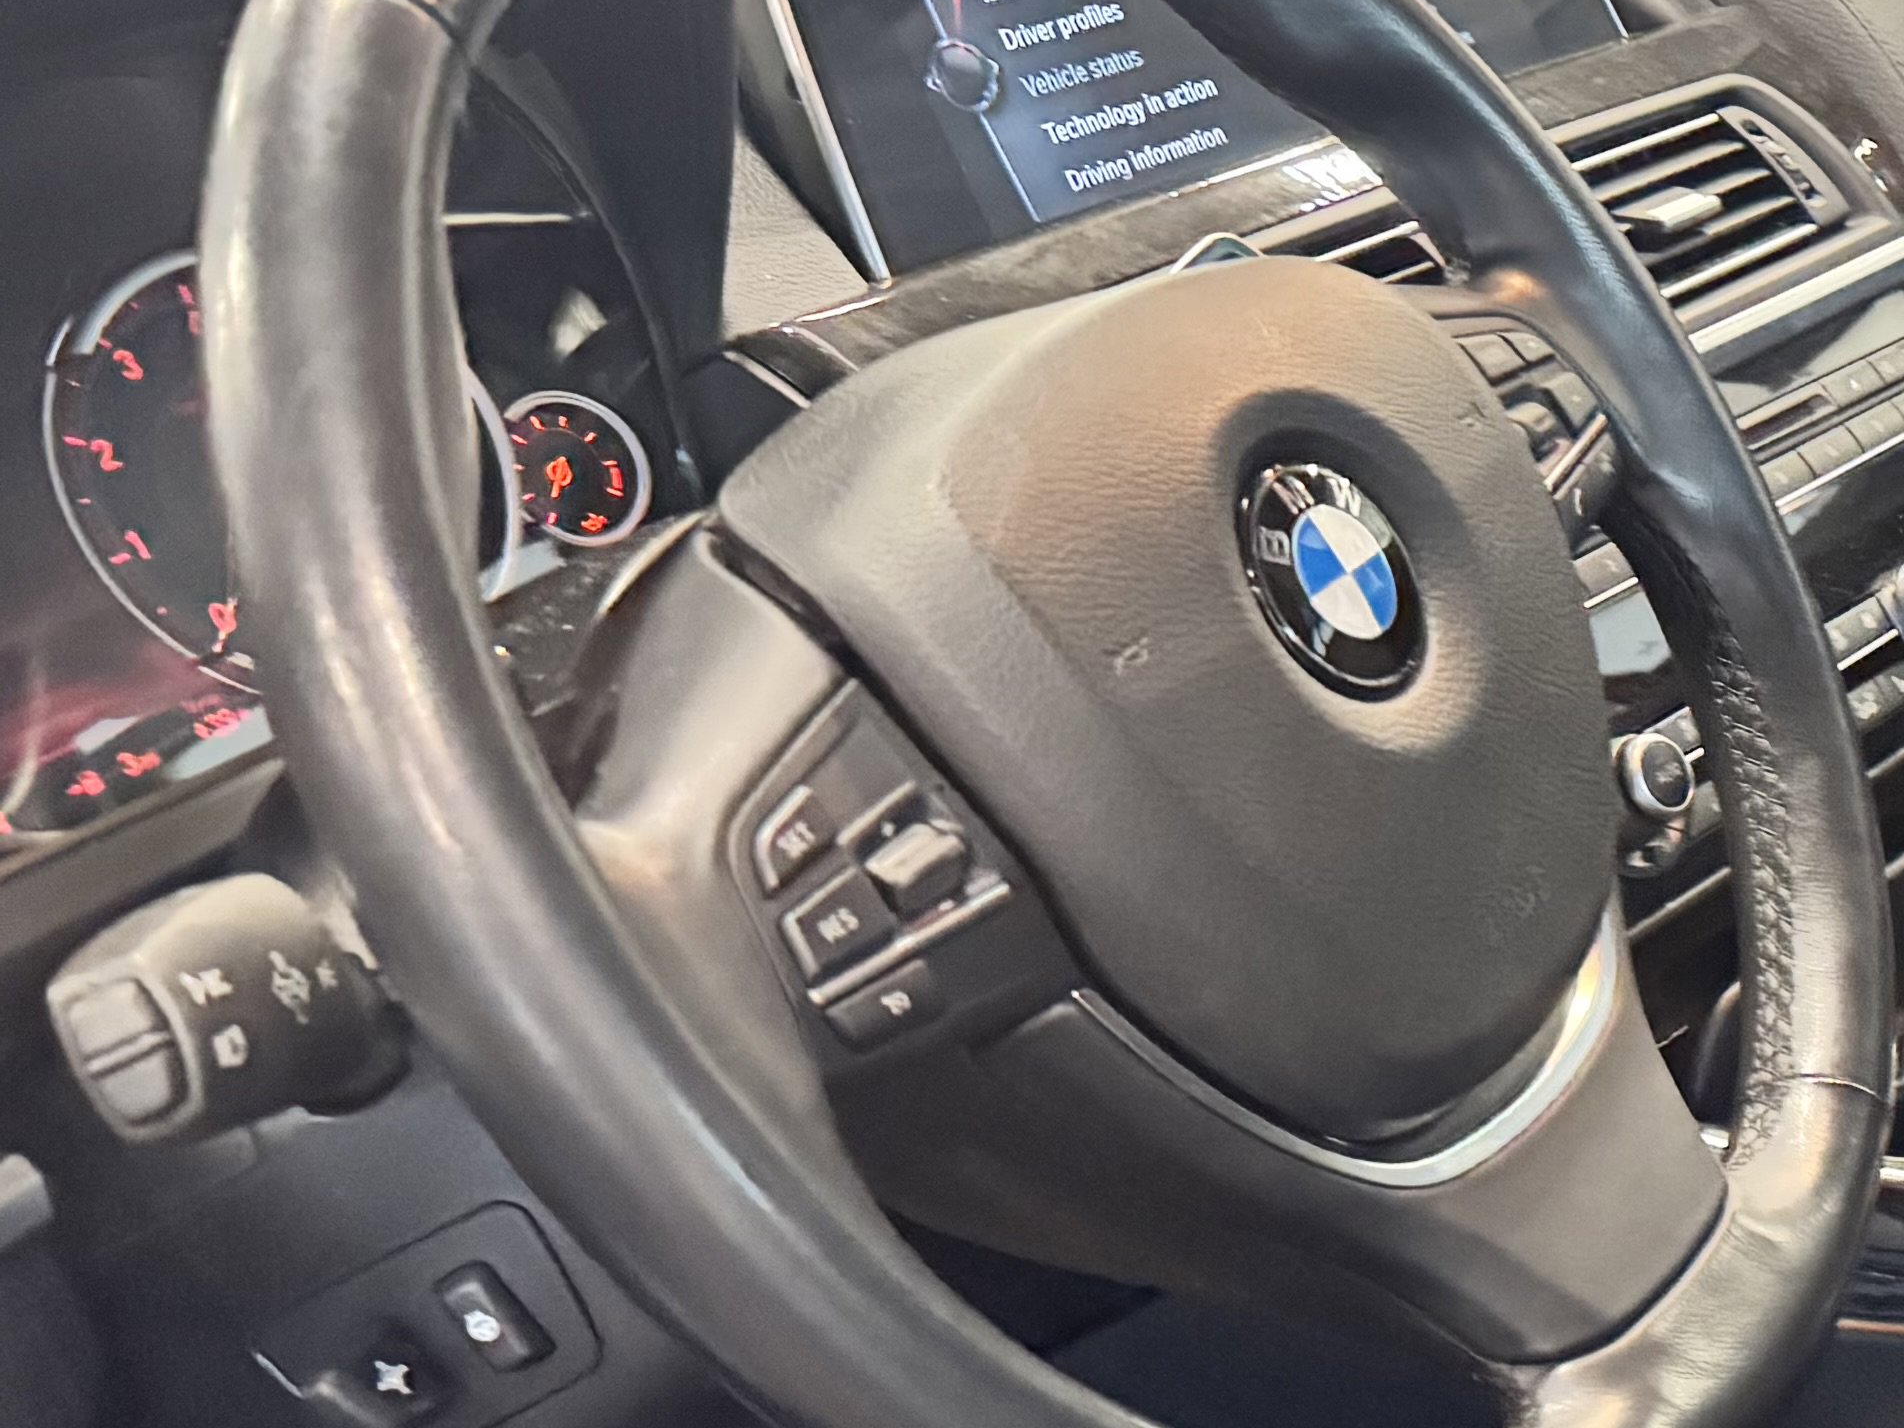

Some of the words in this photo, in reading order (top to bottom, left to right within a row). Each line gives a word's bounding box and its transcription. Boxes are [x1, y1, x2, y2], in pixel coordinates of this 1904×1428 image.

[998, 22, 1056, 52] Driver
[1060, 2, 1125, 41] profiles
[1019, 62, 1089, 98] Vehicle
[1087, 48, 1145, 79] status
[1040, 92, 1148, 146] Technology
[1145, 92, 1167, 115] in
[1165, 77, 1220, 108] action
[1063, 155, 1134, 194] Driving
[1129, 125, 1230, 171] information
[112, 348, 145, 381] 3
[90, 438, 126, 472] 2
